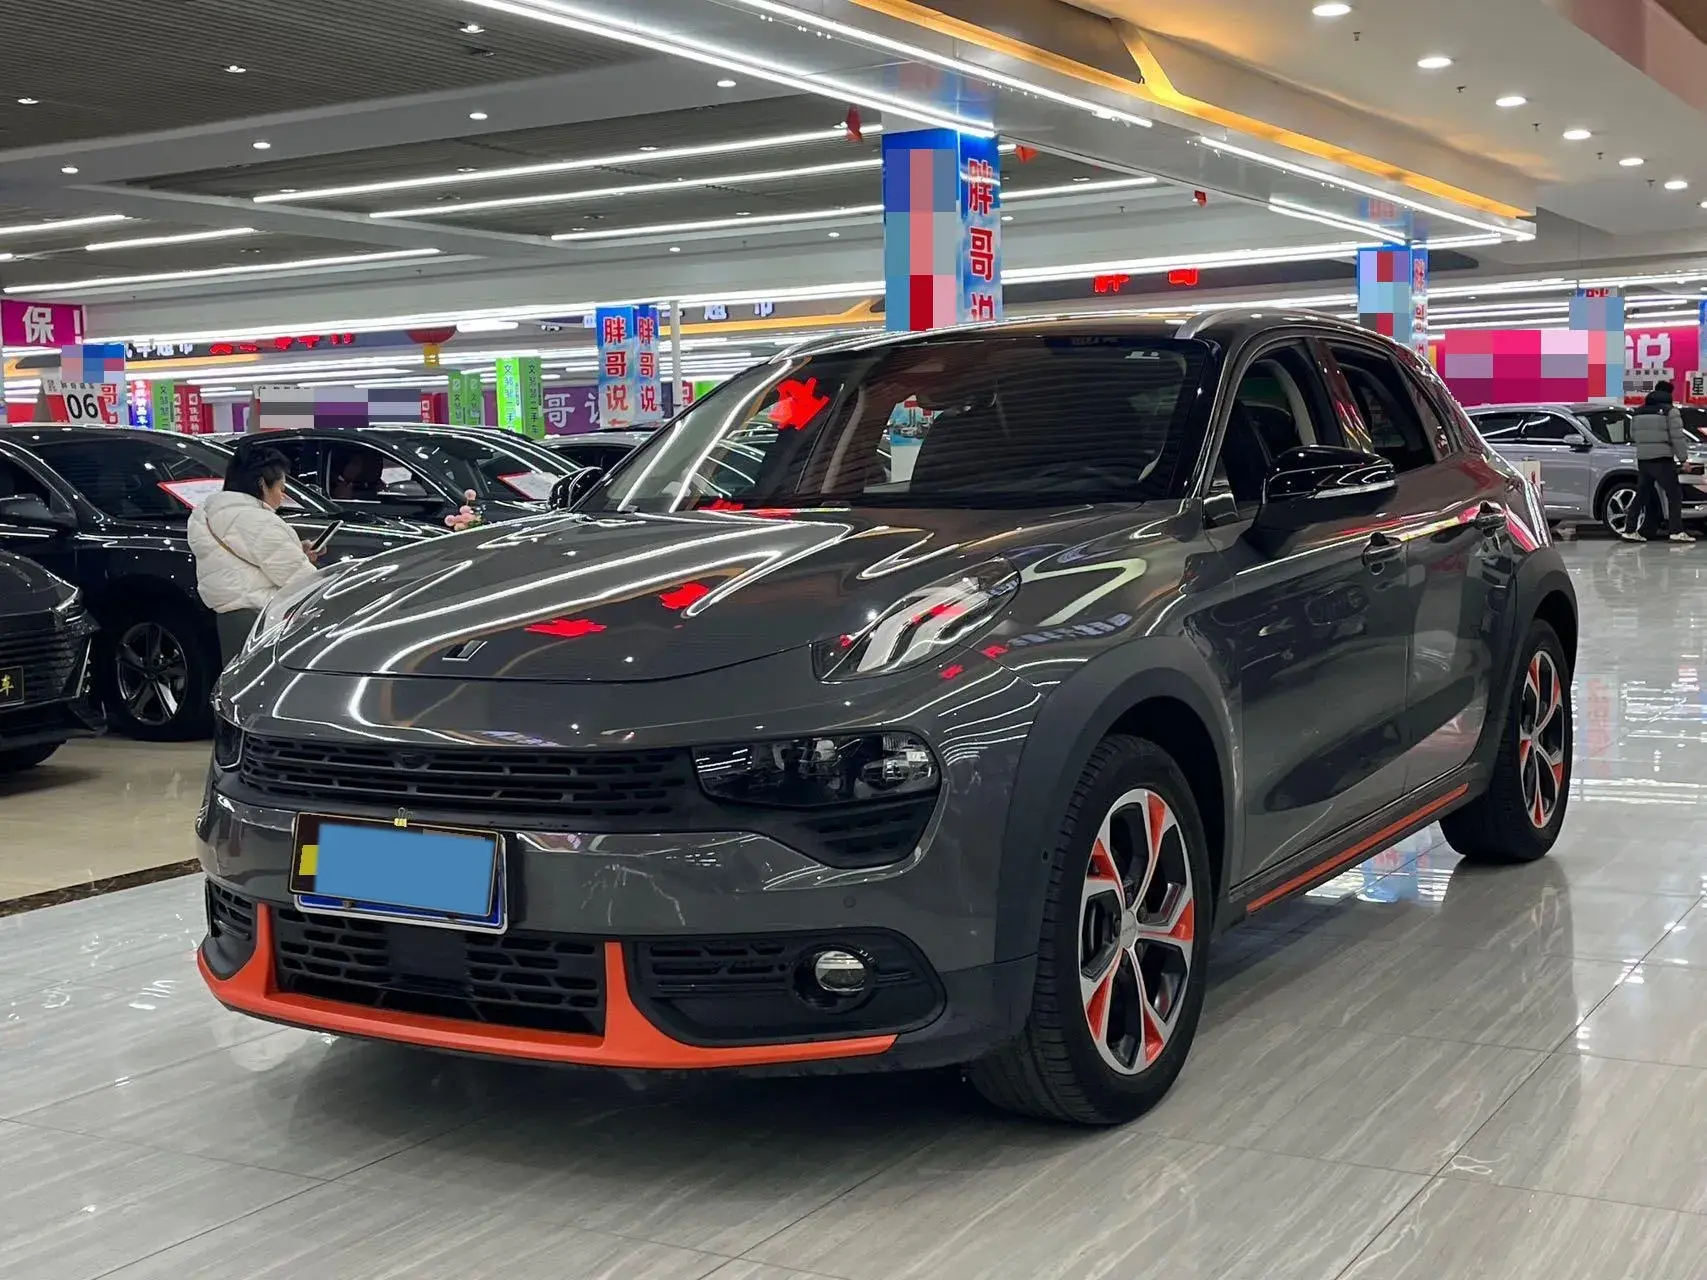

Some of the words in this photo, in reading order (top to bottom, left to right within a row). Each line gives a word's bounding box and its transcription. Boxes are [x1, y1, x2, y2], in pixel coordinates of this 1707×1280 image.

[66, 393, 99, 419] 06
[604, 317, 629, 412] 胖哥说
[638, 317, 657, 413] 胖哥说
